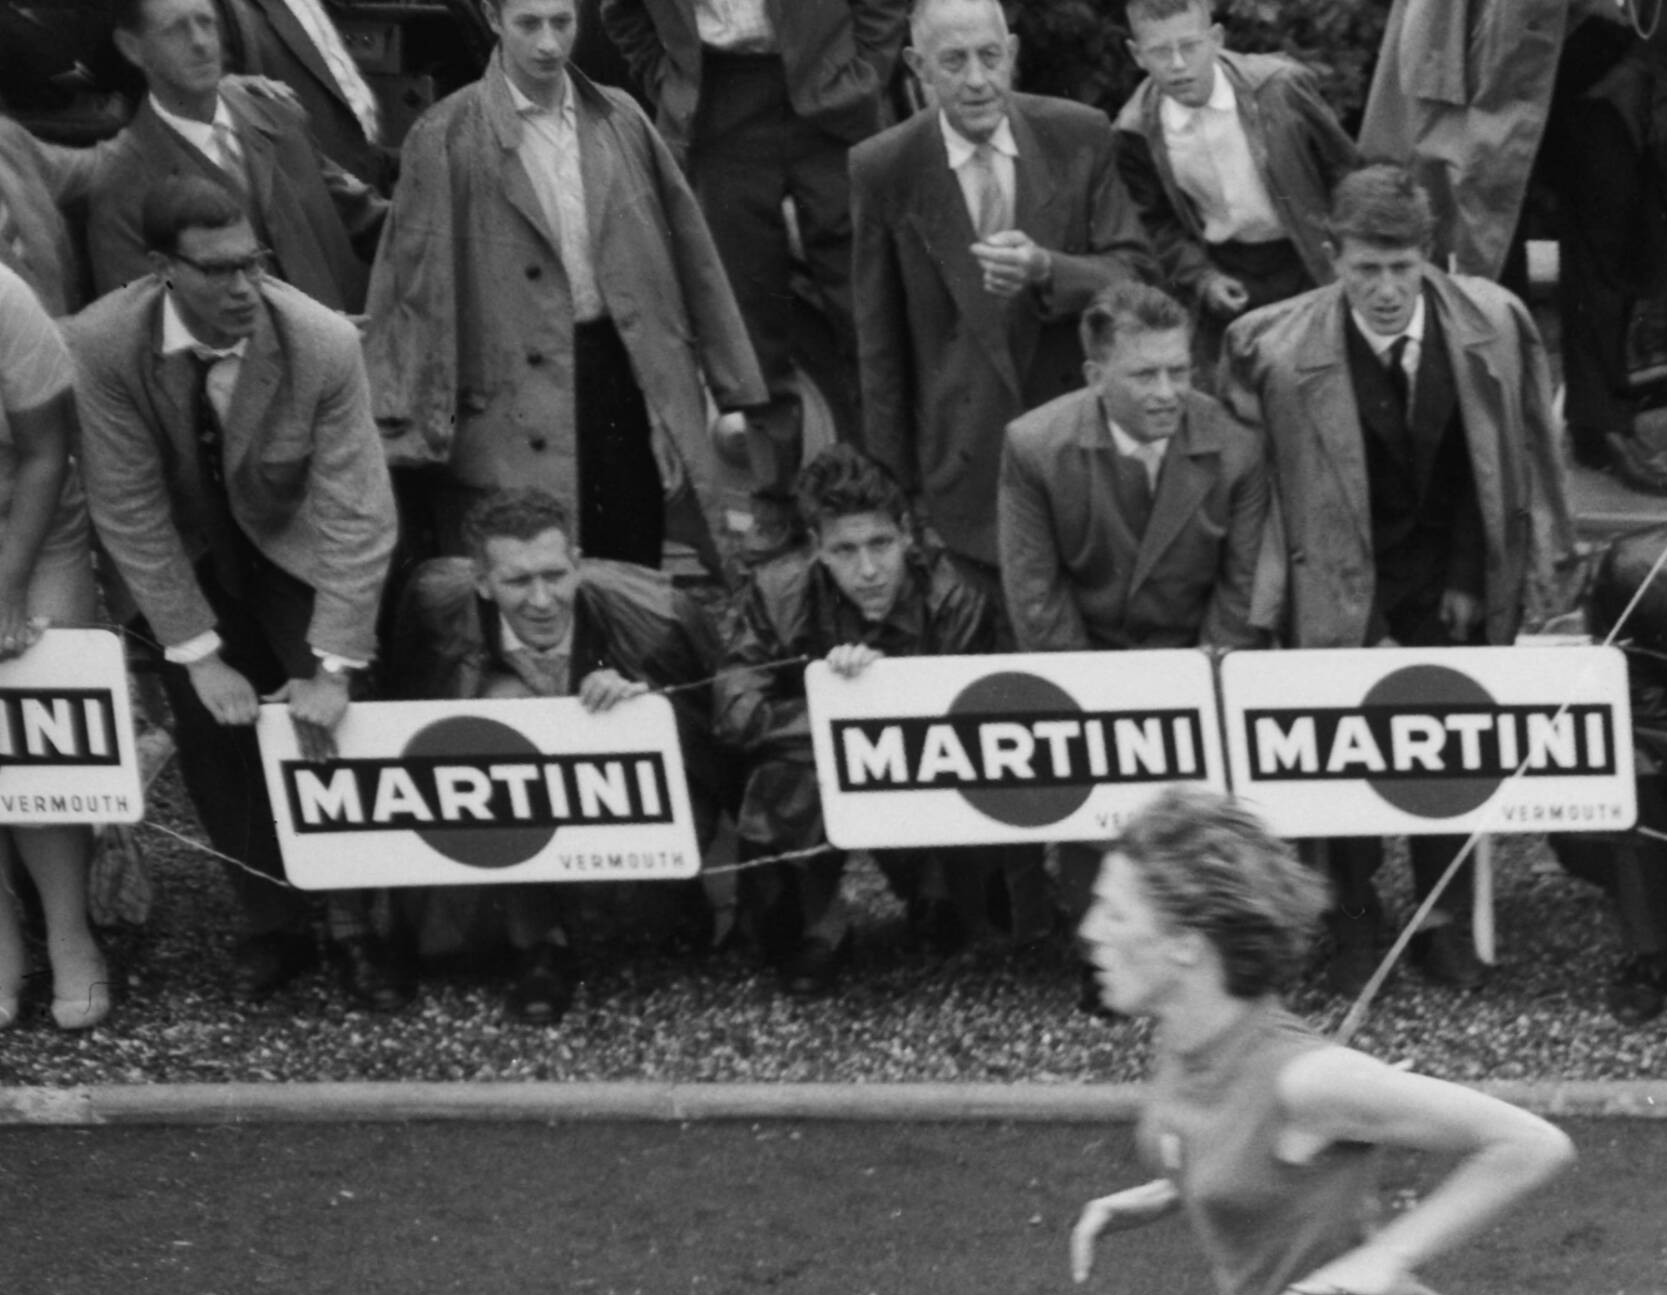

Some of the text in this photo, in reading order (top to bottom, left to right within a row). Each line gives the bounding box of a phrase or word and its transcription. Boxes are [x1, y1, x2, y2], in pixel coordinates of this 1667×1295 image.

[842, 716, 1196, 785] MARTINI
[1254, 711, 1606, 774] MARTINI
[1, 795, 130, 813] VERMOUTH
[294, 759, 662, 825] MARTINI
[1503, 805, 1621, 821] VERMOUTH
[558, 850, 686, 870] VERMOUTH
